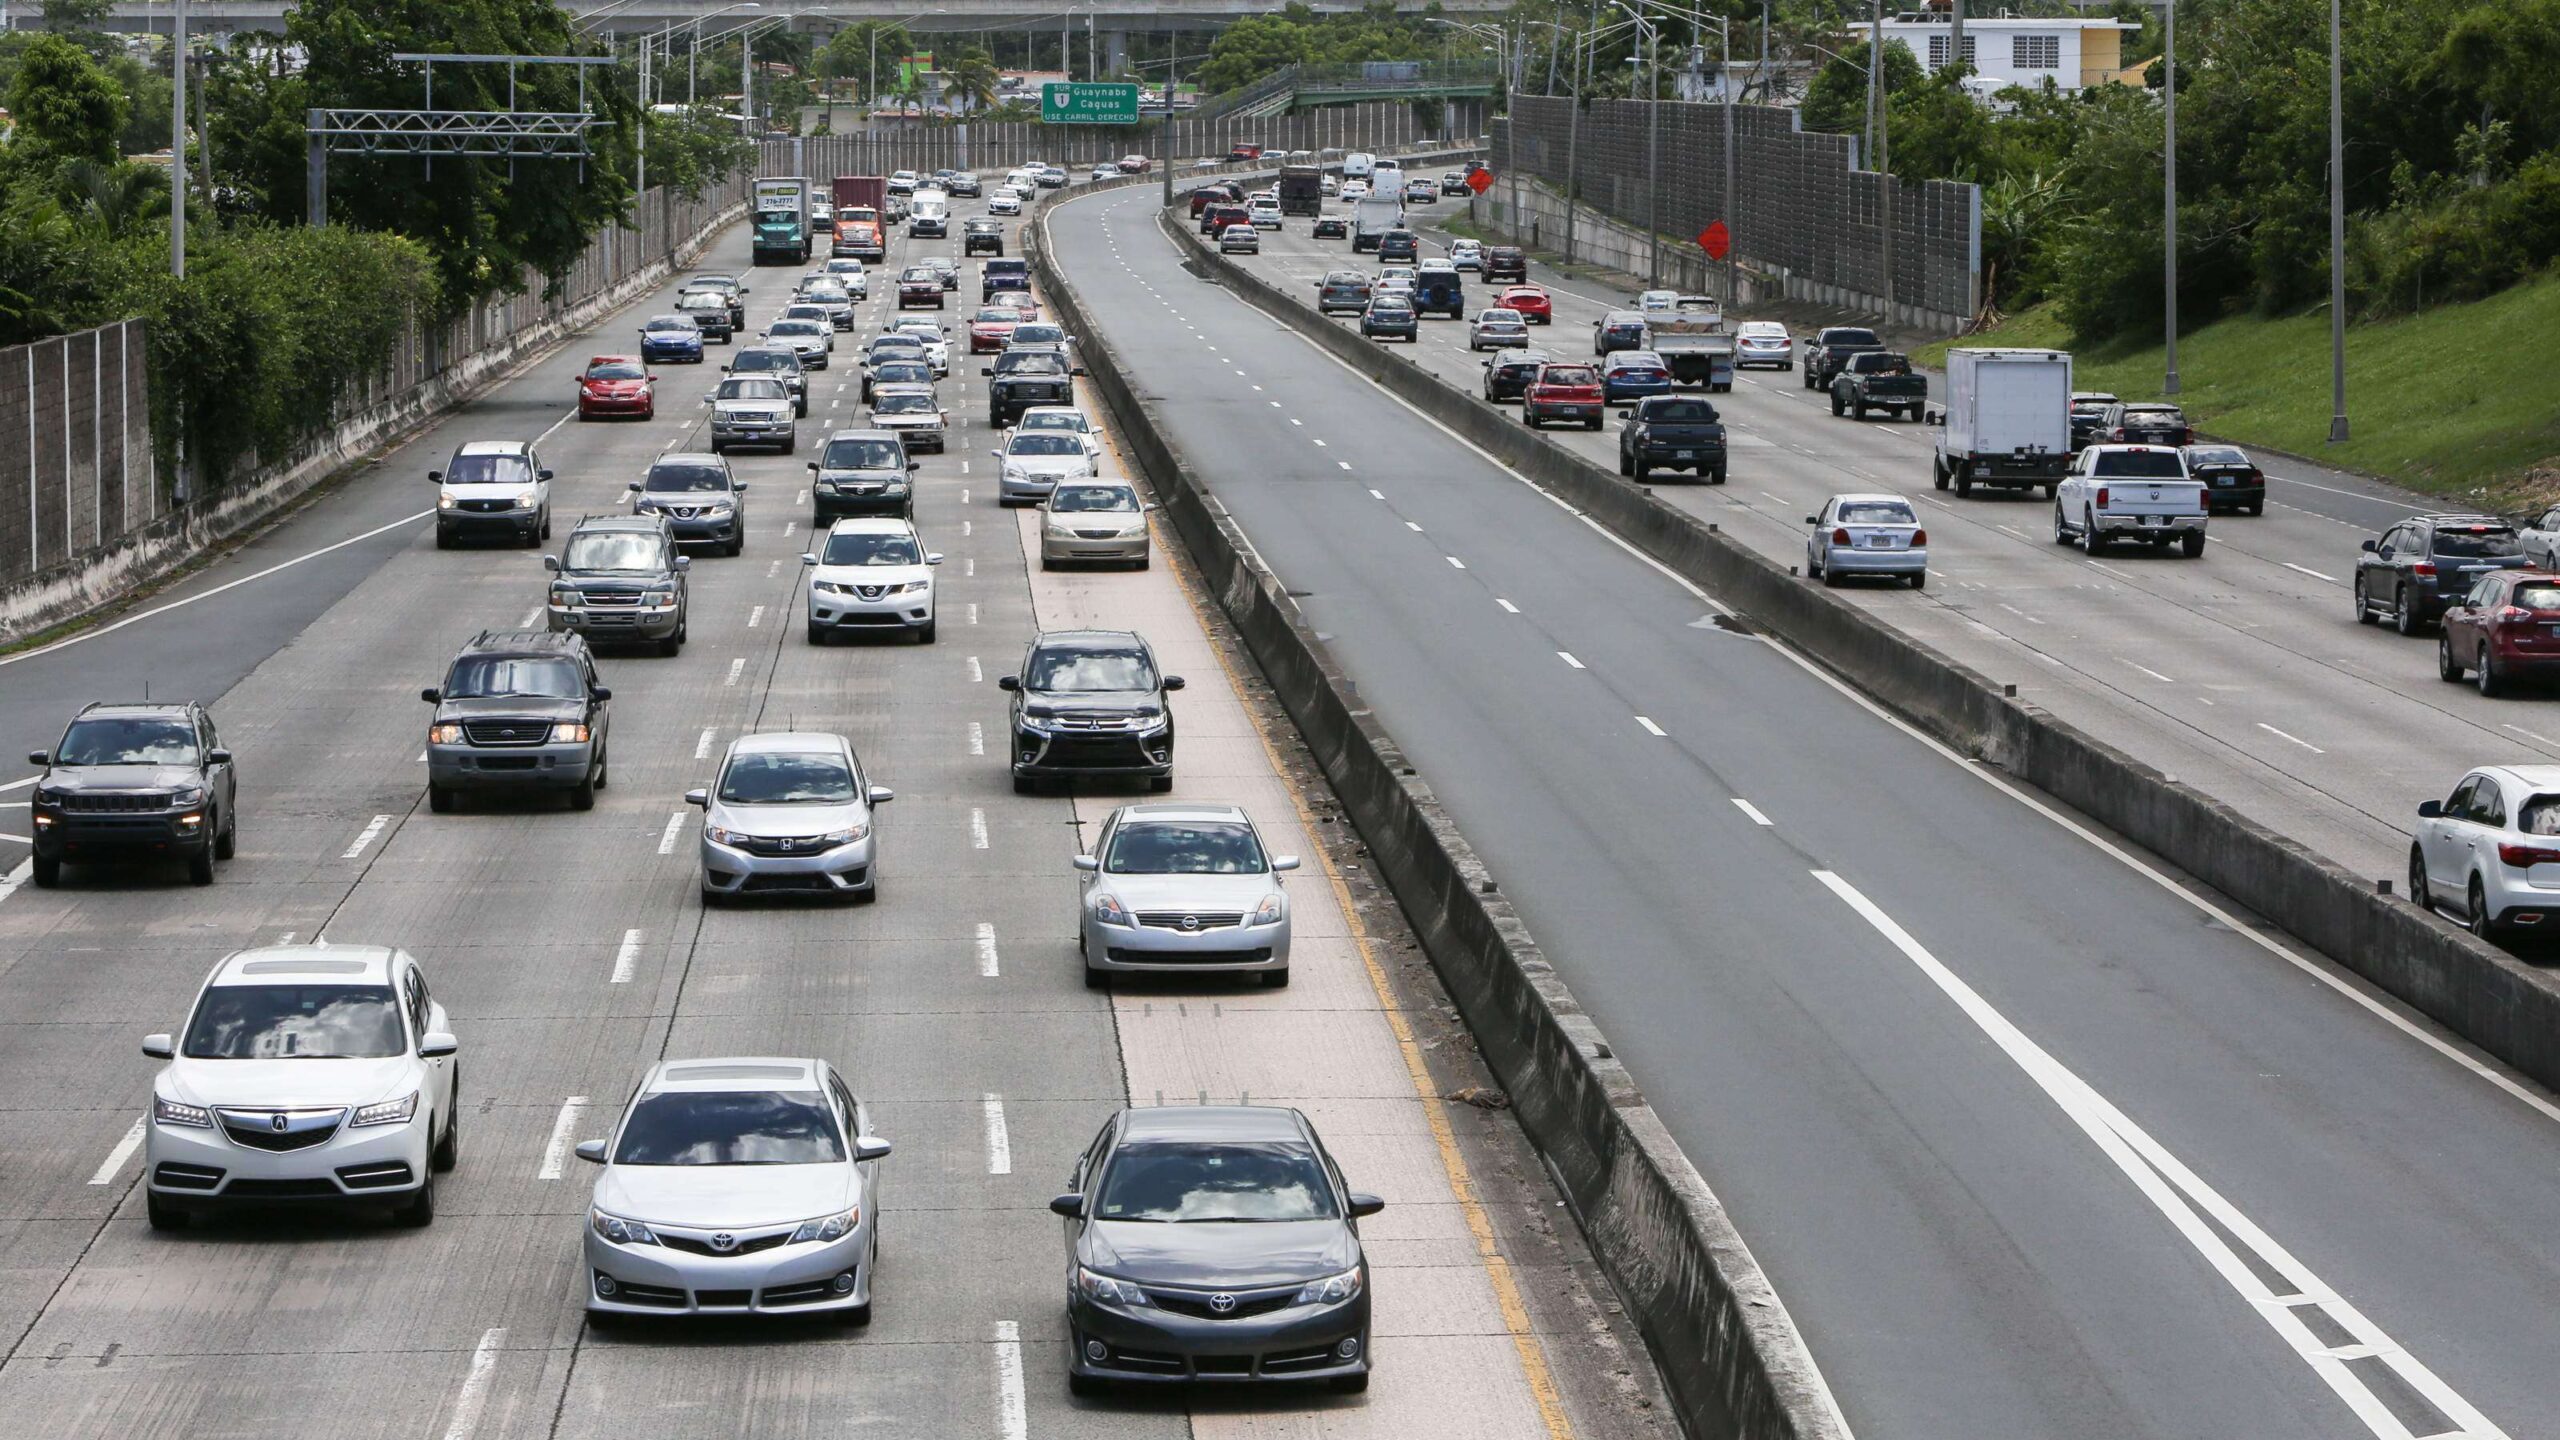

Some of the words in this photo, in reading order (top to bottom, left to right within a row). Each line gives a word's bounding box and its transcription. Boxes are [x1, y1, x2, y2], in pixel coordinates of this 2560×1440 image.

[1073, 88, 1127, 97] Guaynabo
[1060, 95, 1064, 104] 1
[1080, 99, 1120, 110] Caguas
